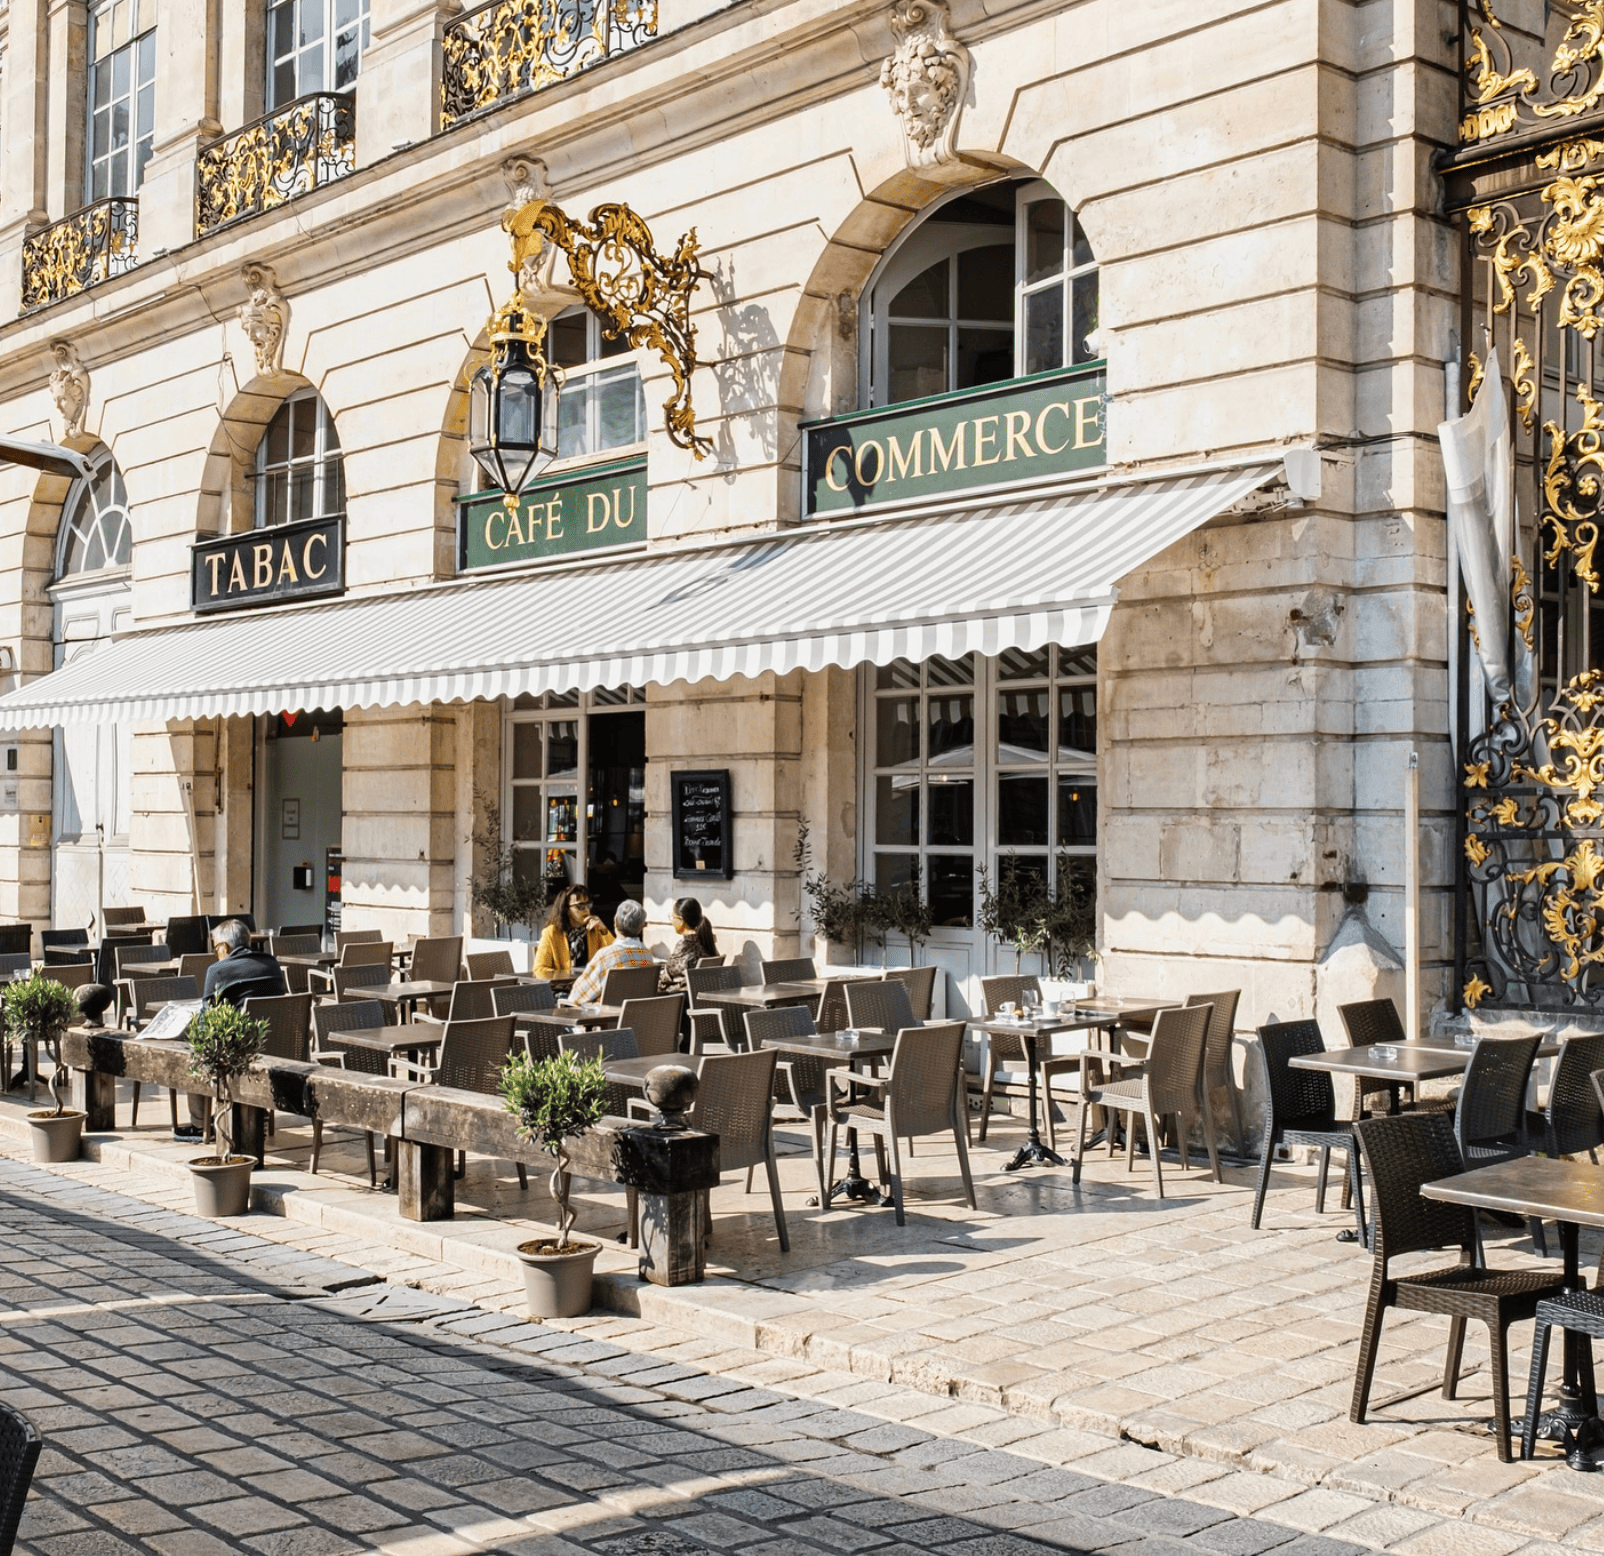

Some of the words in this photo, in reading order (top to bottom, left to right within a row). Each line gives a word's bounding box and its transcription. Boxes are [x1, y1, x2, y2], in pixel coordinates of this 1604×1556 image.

[824, 394, 1105, 492] COMMERCE
[485, 492, 564, 550] CAFÉ
[586, 485, 637, 534] DU
[205, 533, 327, 596] TABAC
